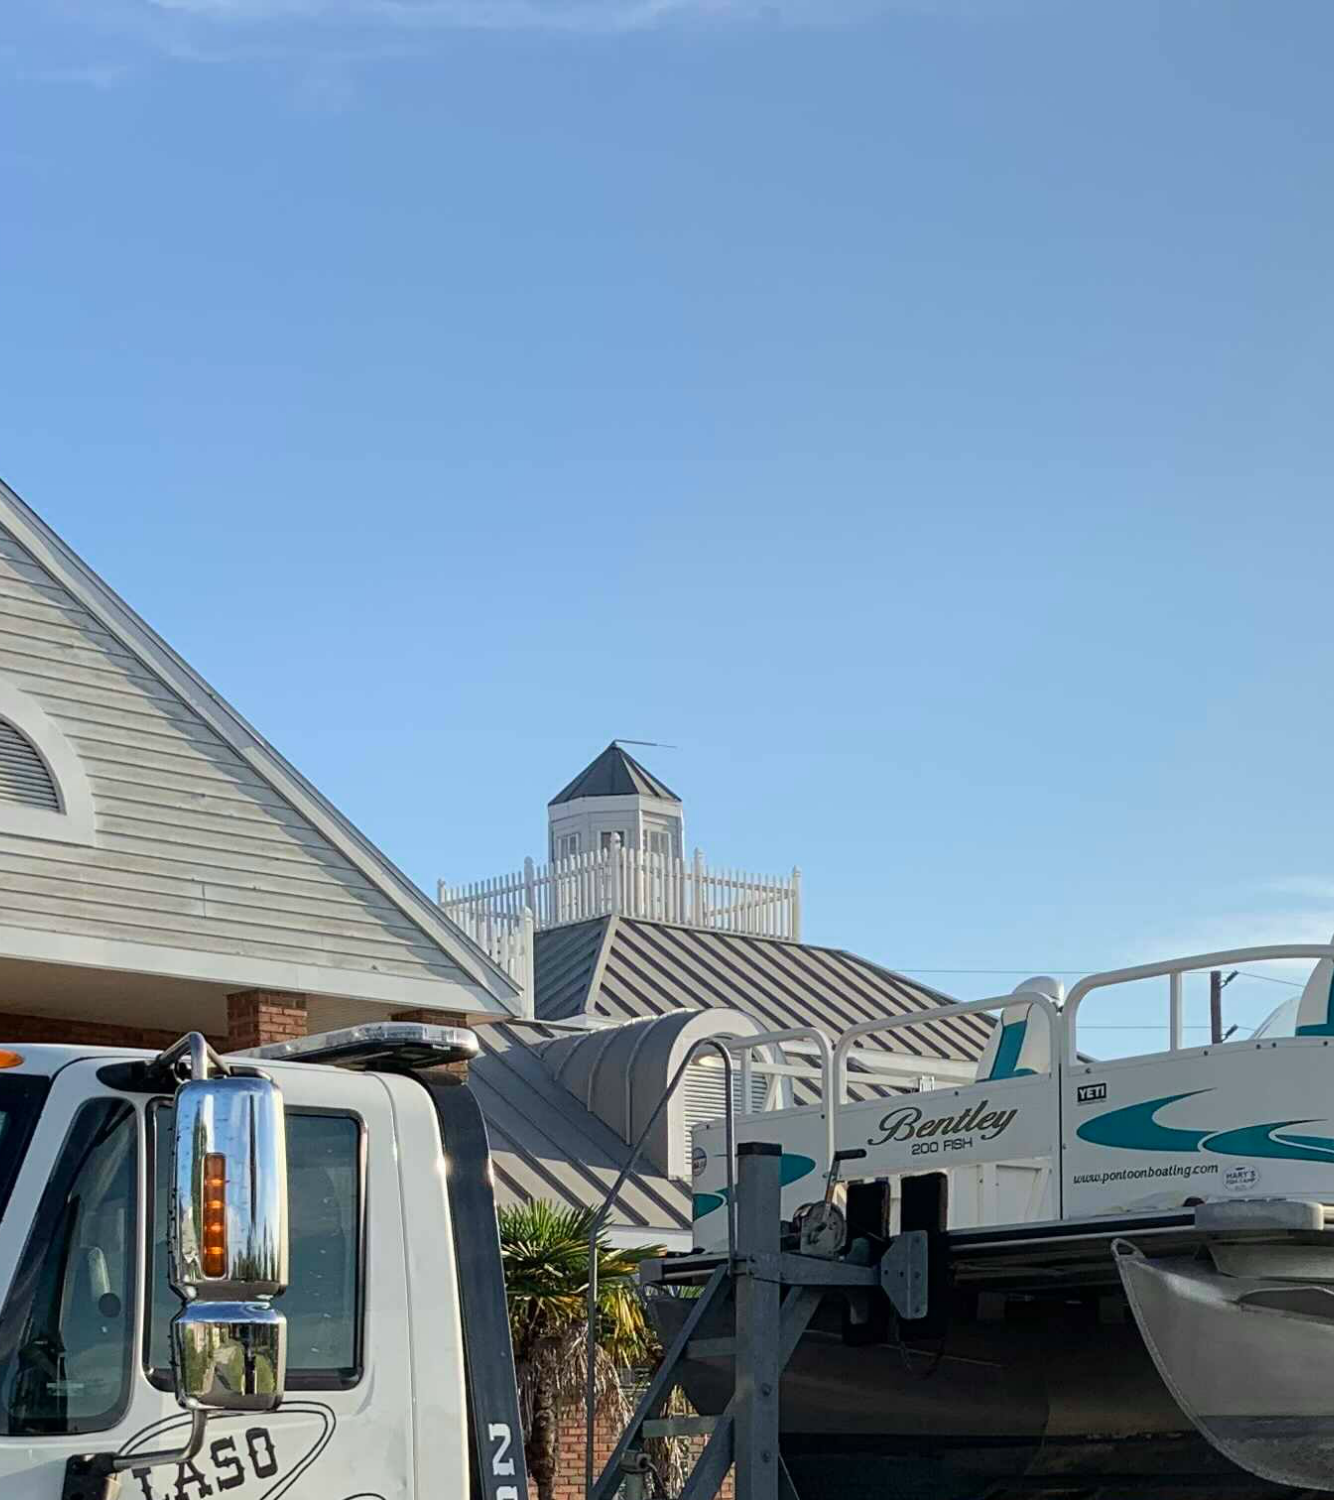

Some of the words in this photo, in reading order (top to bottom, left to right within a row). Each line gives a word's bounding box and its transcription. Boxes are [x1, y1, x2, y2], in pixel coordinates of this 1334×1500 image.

[1078, 1085, 1105, 1100] YETI
[867, 1100, 1019, 1146] Bentley
[911, 1143, 939, 1155] 200
[943, 1137, 973, 1152] FISH
[1073, 1164, 1219, 1184] www.pontoonboating.com
